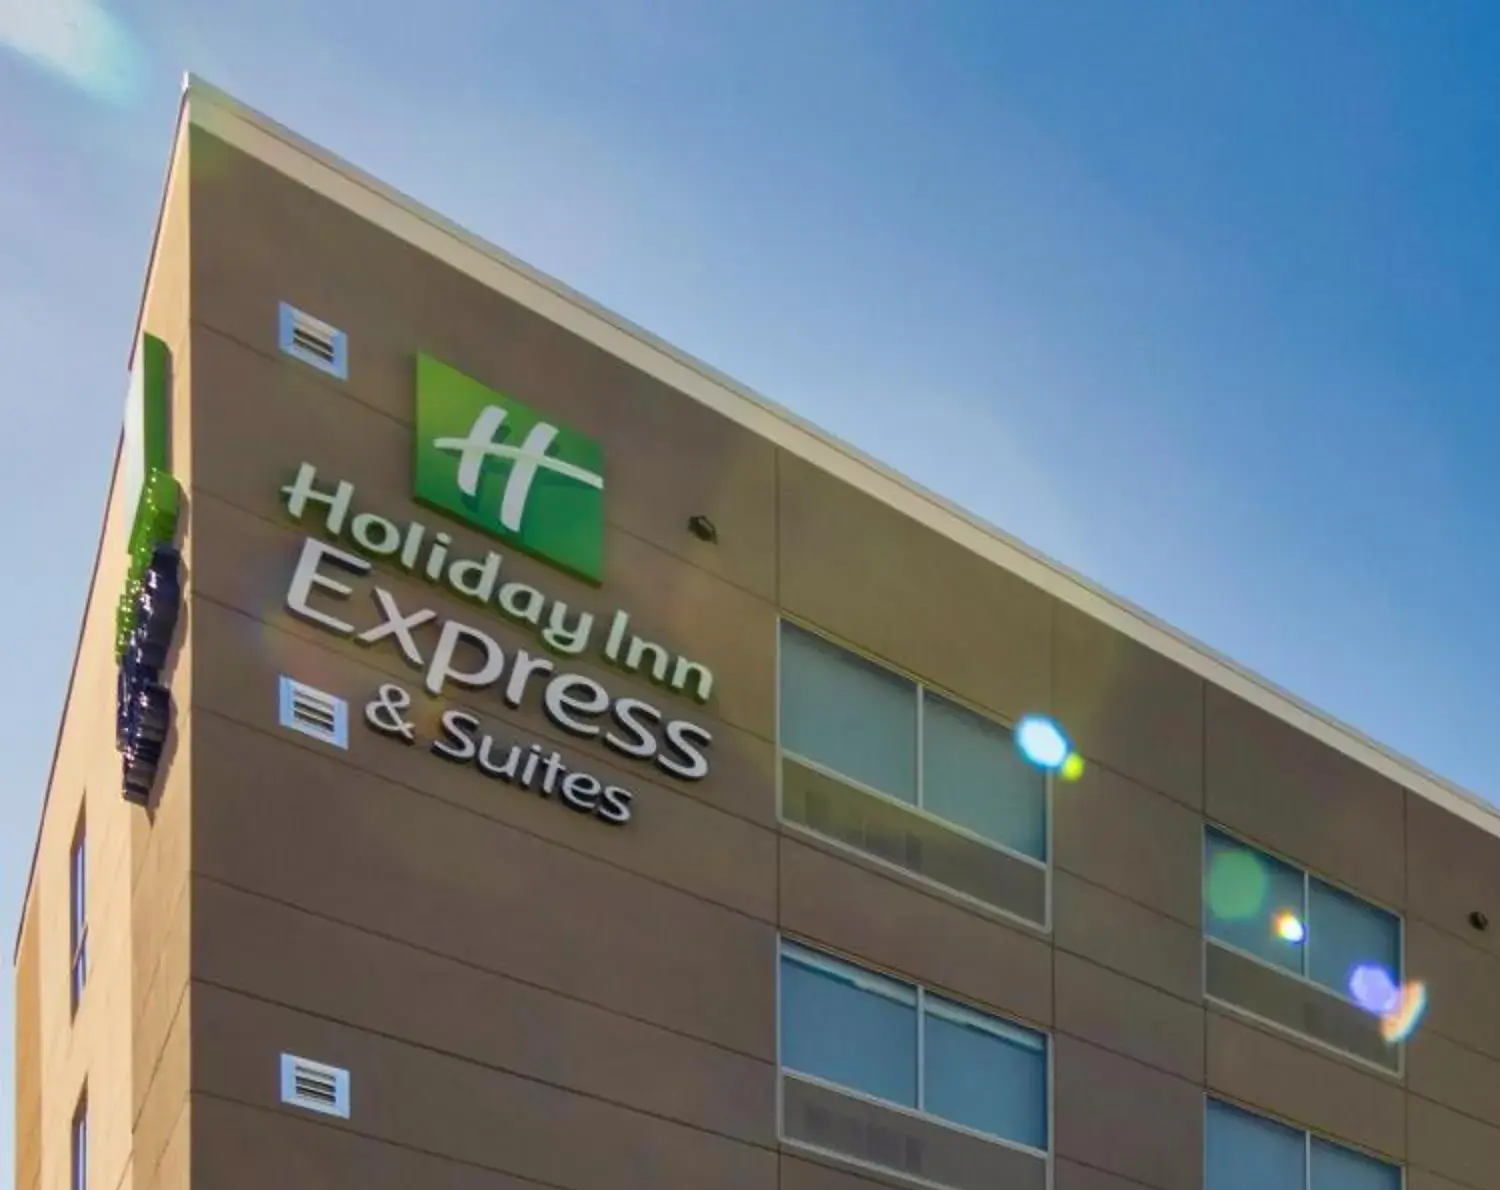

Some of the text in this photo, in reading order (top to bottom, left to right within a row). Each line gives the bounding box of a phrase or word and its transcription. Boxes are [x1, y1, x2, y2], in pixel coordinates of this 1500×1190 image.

[433, 404, 604, 533] H
[282, 462, 593, 653] Holiday
[605, 611, 714, 700] Inn
[286, 537, 712, 780] Express
[364, 684, 633, 824] & Suites
